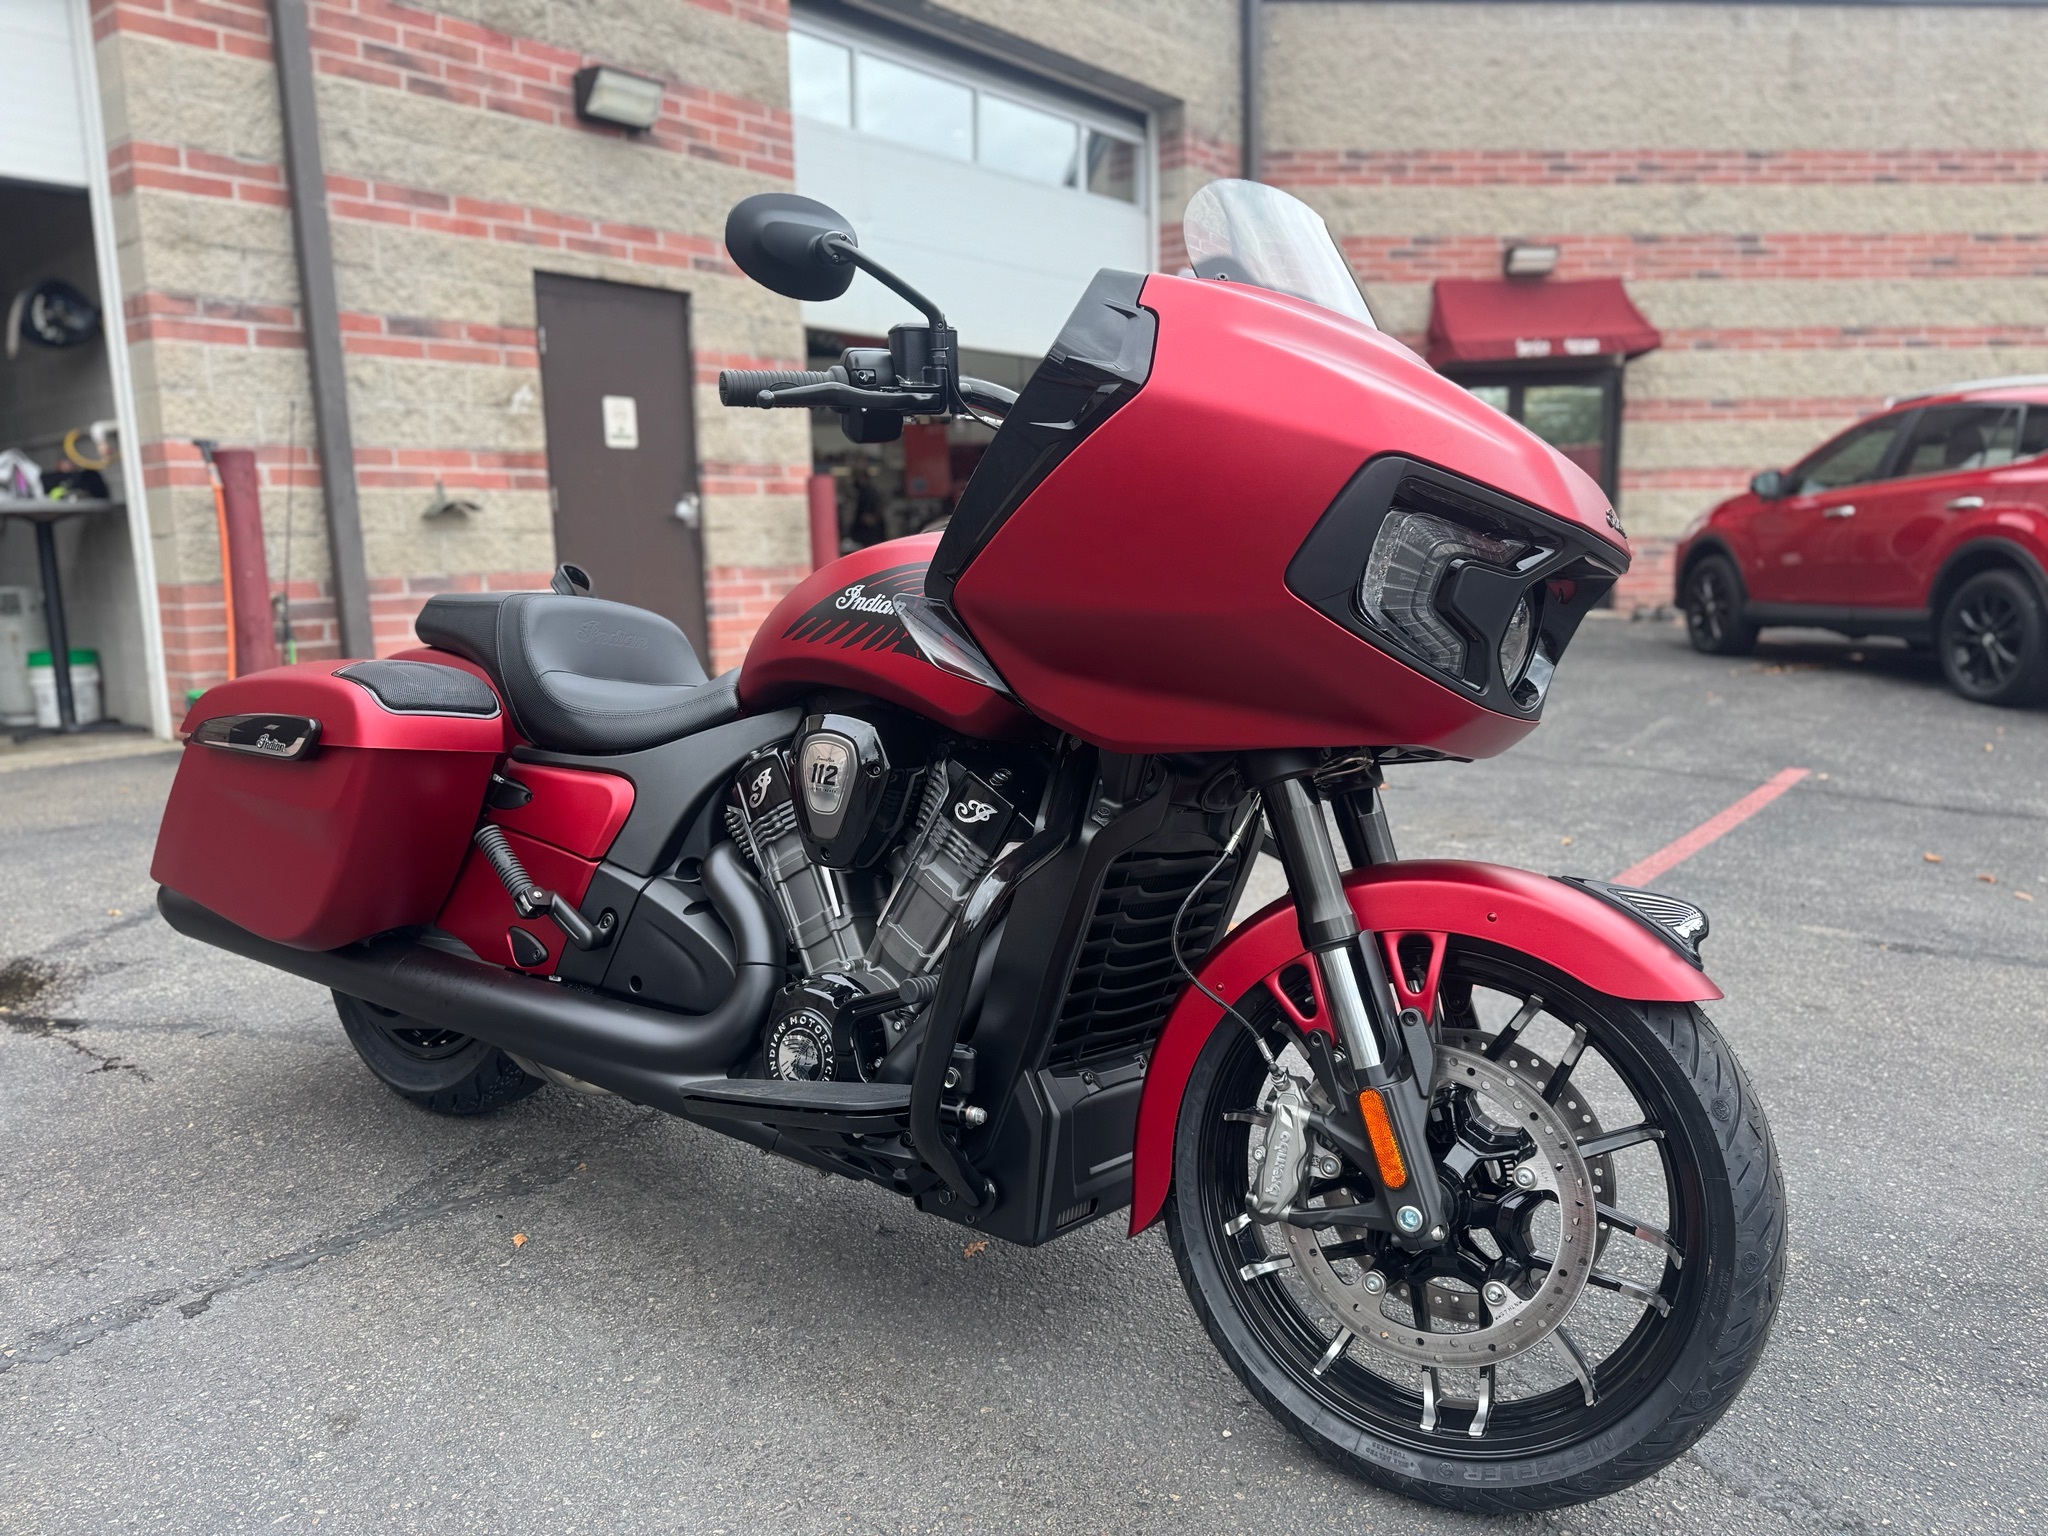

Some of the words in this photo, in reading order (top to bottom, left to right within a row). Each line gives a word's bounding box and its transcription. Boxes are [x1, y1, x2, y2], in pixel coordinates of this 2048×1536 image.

[576, 619, 649, 649] Indian
[256, 733, 286, 753] Indian
[811, 762, 838, 786] 112
[769, 1022, 786, 1078] INDIAN
[790, 1016, 834, 1082] MOTORCYCL
[1265, 1130, 1291, 1197] brembo
[1372, 1441, 1406, 1460] TUBELESS
[1463, 1432, 1617, 1481] METZELER
